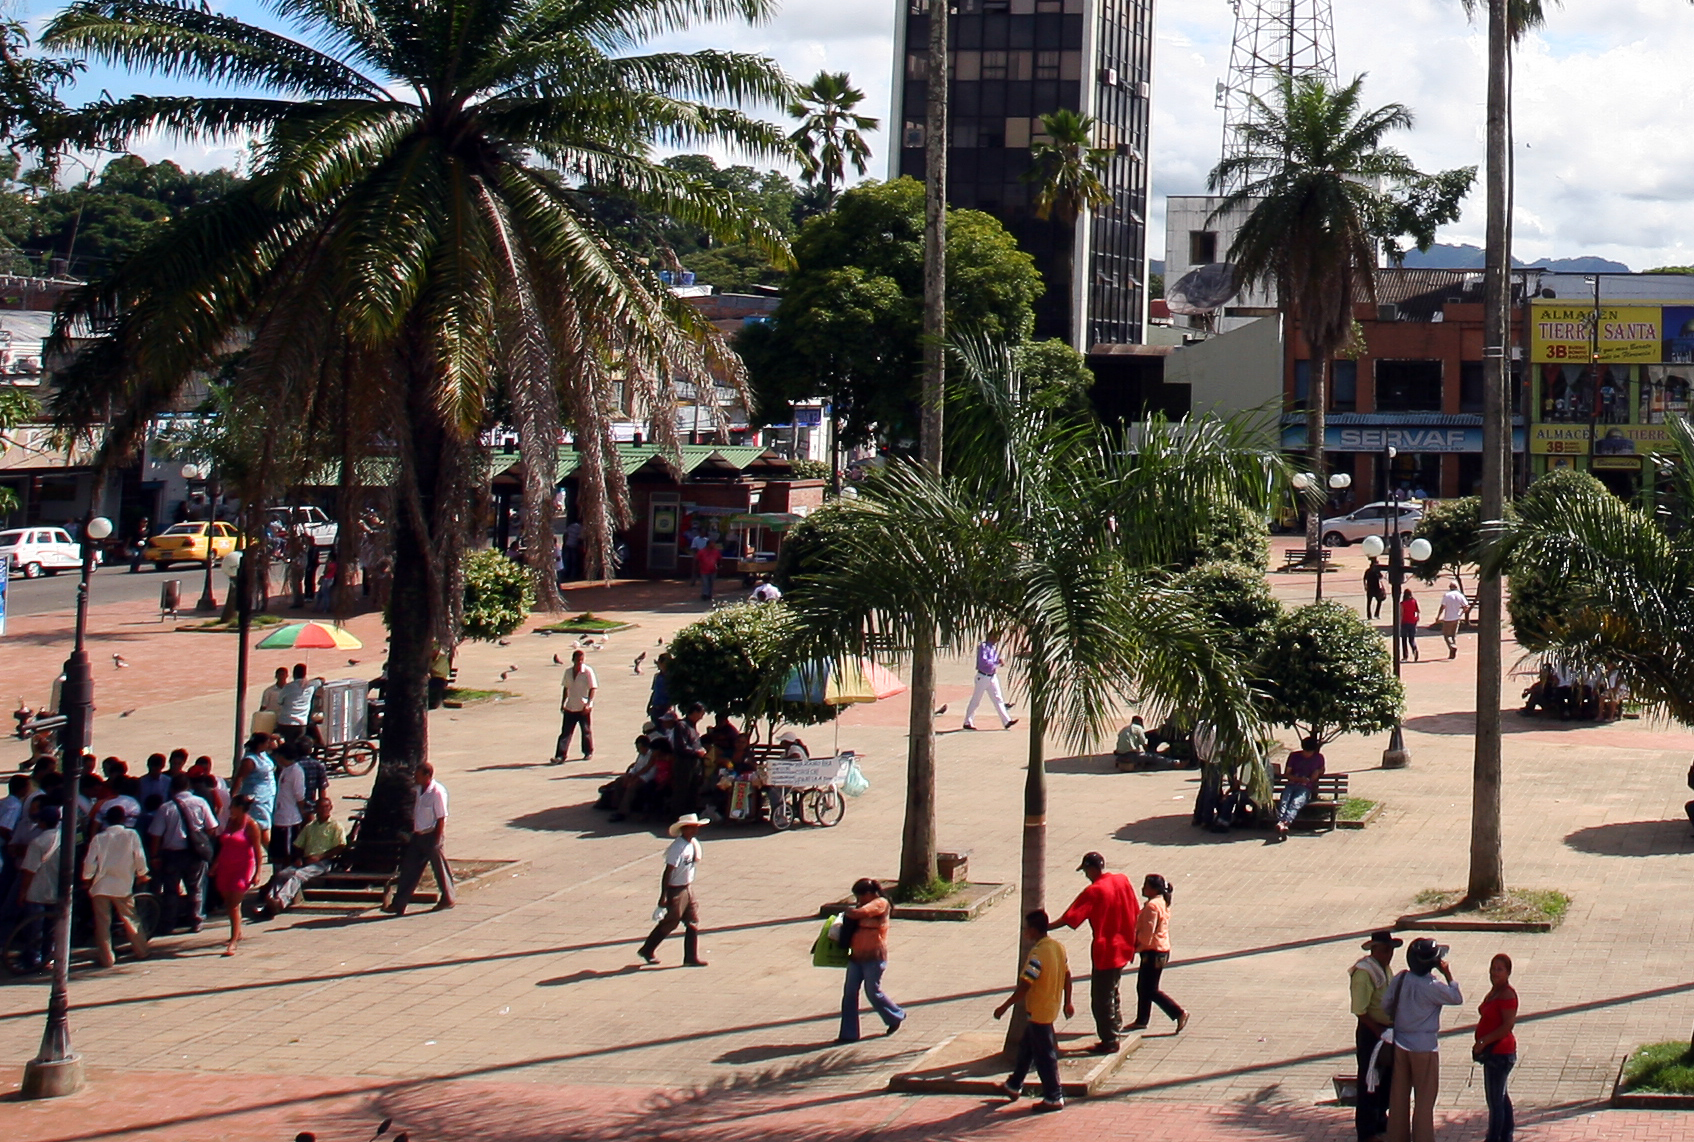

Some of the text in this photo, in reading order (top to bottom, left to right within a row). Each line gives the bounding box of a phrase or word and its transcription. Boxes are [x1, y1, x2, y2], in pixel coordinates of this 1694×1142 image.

[1604, 322, 1656, 340] SANTA
[1546, 344, 1568, 359] 3B
[1340, 429, 1465, 446] SERVAF
[1546, 441, 1564, 453] 3B
